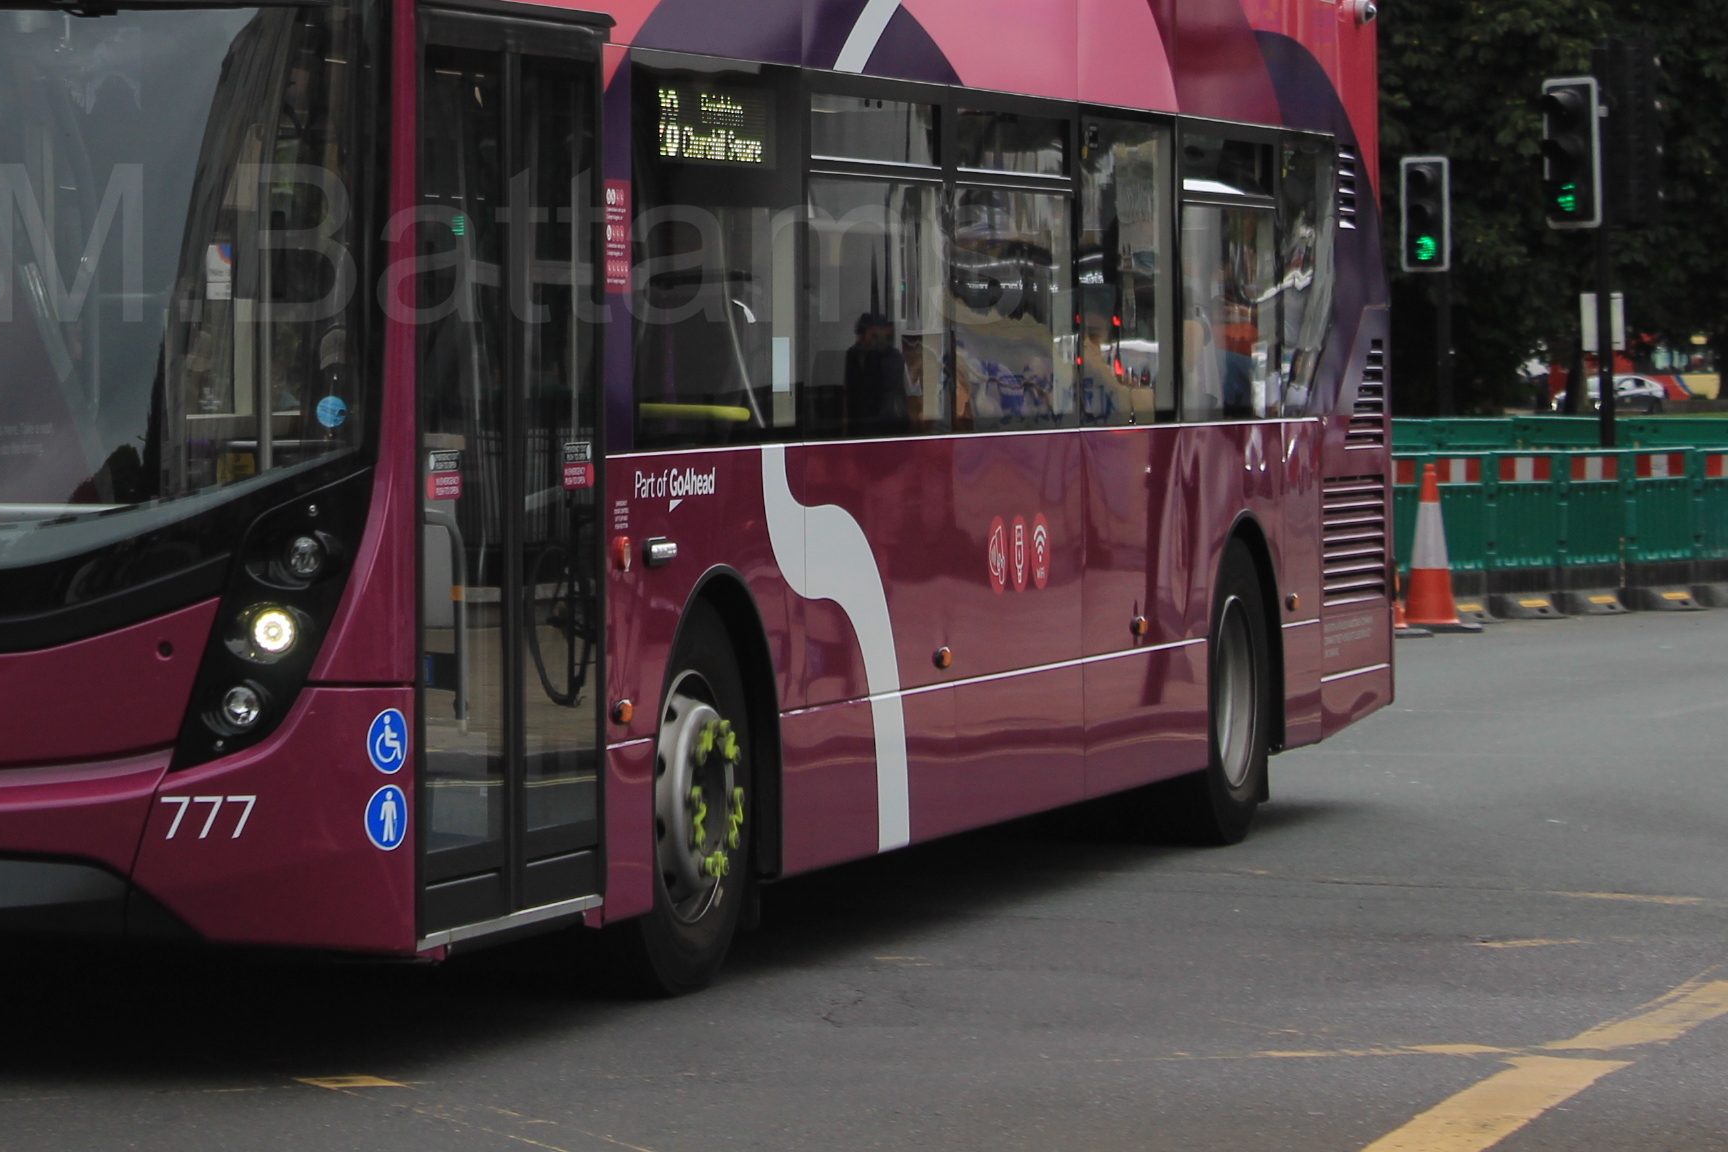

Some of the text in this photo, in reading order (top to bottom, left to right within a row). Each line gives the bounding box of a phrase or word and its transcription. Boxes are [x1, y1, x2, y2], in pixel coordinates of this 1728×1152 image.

[634, 467, 716, 499] Part of GoAhead
[160, 795, 257, 840] 777
